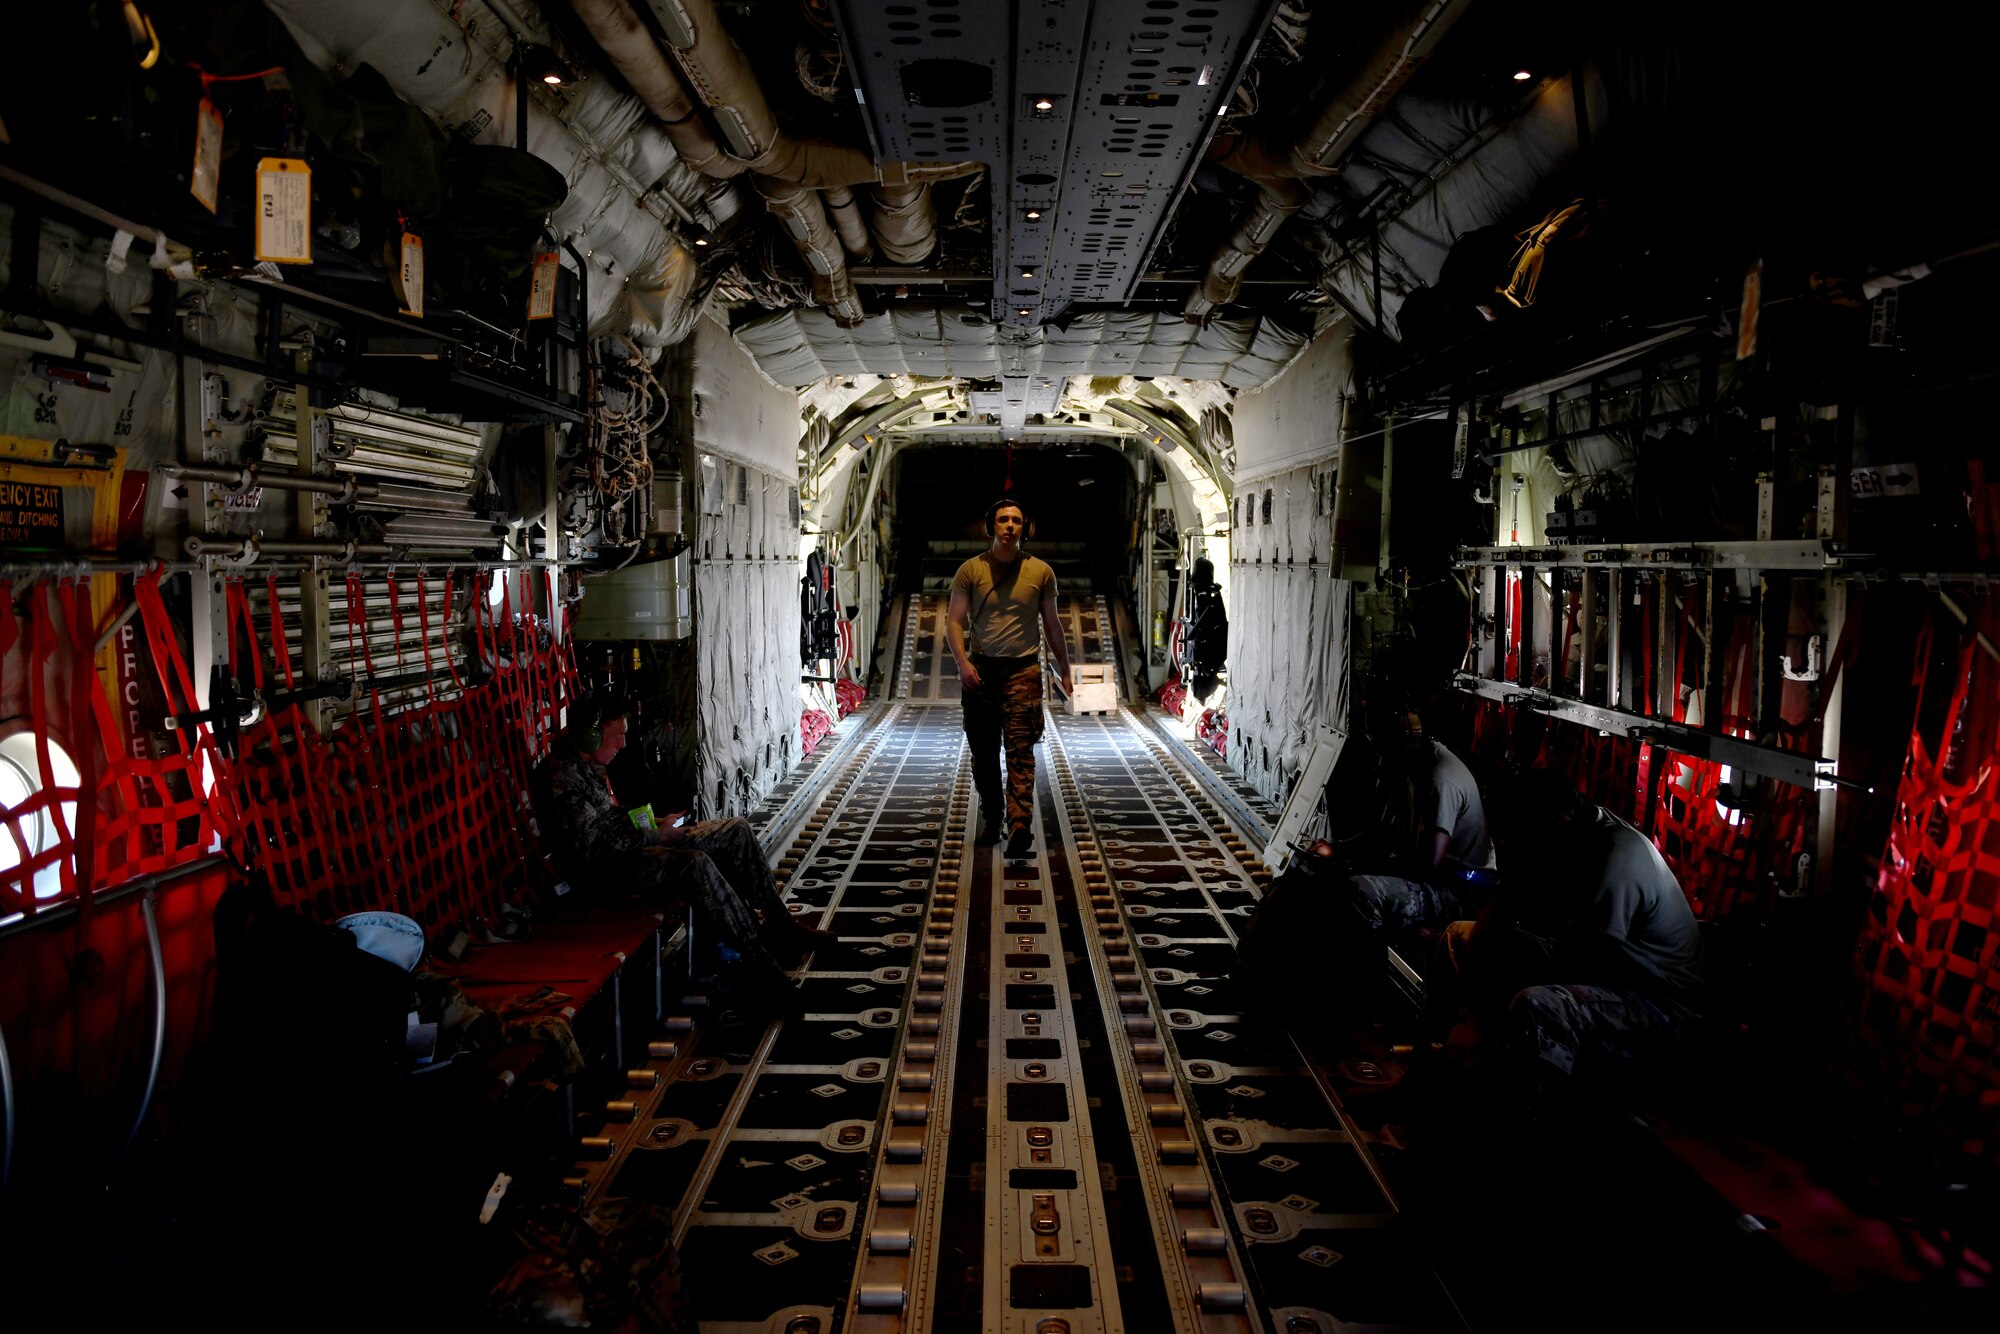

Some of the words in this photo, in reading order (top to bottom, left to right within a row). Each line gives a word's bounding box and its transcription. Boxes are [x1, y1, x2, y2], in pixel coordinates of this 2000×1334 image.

[120, 408, 134, 422] LS
[1849, 471, 1884, 493] GER
[0, 484, 31, 506] ENCY
[34, 487, 59, 509] EXIT
[0, 510, 13, 525] AND
[18, 511, 59, 528] DITCHING
[6, 527, 31, 543] ONLY
